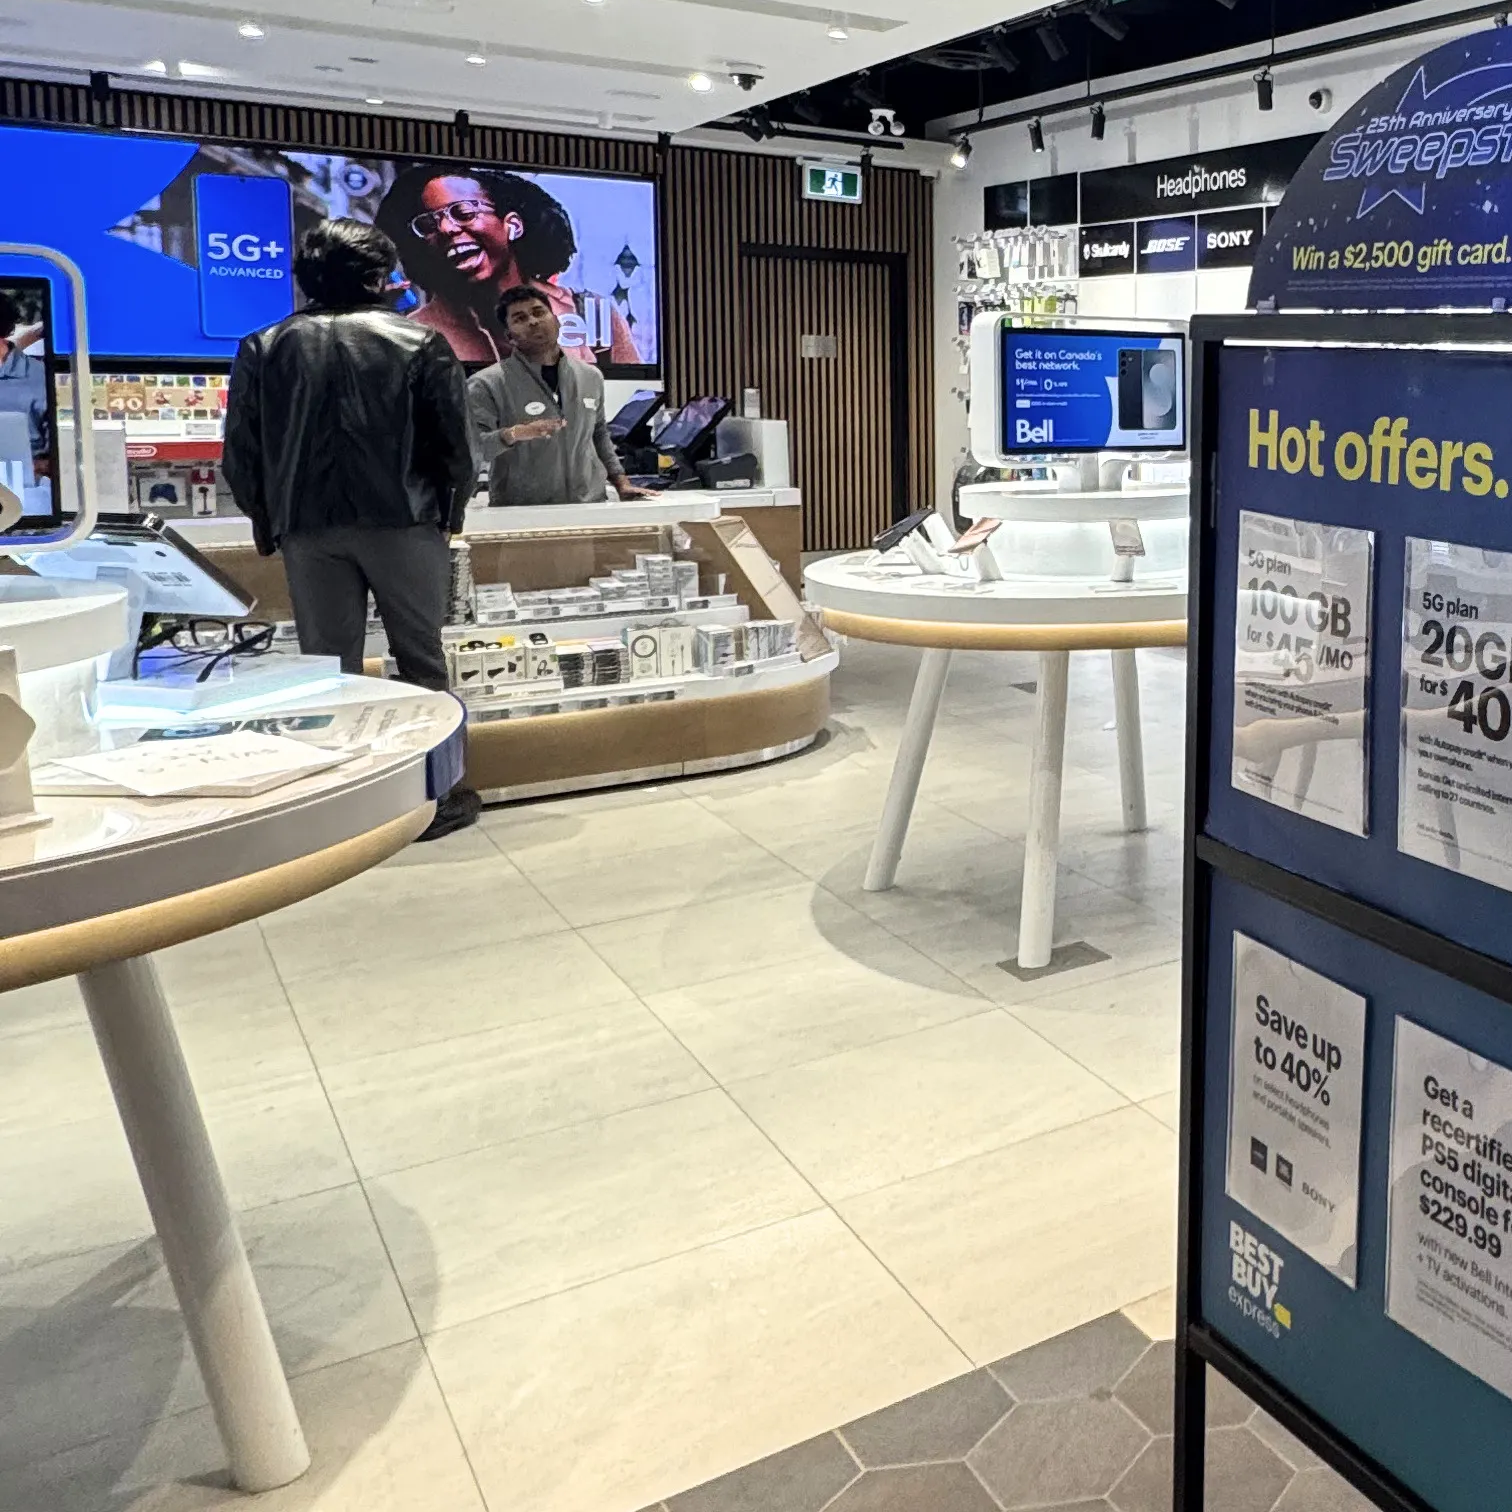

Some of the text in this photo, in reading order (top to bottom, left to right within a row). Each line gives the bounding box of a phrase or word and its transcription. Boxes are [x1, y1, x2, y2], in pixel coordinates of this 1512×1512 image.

[1366, 115, 1406, 135] 25th
[1156, 167, 1247, 199] Headphones
[207, 232, 285, 262] 5G+
[1141, 236, 1191, 255] BOSE
[1206, 230, 1253, 249] SONY
[1292, 235, 1512, 273] Win a $2,500 gift card.
[209, 266, 284, 279] ADVANCED
[557, 297, 612, 347] ell
[1015, 348, 1103, 361] Get it on Canada's
[1015, 361, 1038, 370] best
[109, 397, 143, 411] 40
[1015, 419, 1054, 443] Bell
[1248, 408, 1510, 500] Hot offers.
[1247, 549, 1292, 575] 5G plan
[1305, 591, 1352, 639] GB
[1422, 591, 1479, 620] 5G plan
[1419, 674, 1437, 695] for
[1255, 994, 1342, 1074] Save up
[1254, 1035, 1331, 1107] to 40%
[1423, 1075, 1474, 1120] Get a
[1421, 1133, 1459, 1173] PS5
[1420, 1169, 1499, 1226] console
[1419, 1194, 1502, 1259] $229.99
[1229, 1219, 1284, 1285] BEST
[1418, 1231, 1443, 1255] with
[1444, 1248, 1469, 1271] new
[1471, 1260, 1493, 1286] Bell
[1231, 1252, 1279, 1309] BUY
[1426, 1254, 1441, 1276] TV
[1442, 1269, 1509, 1320] activations.
[1227, 1285, 1280, 1339] express
